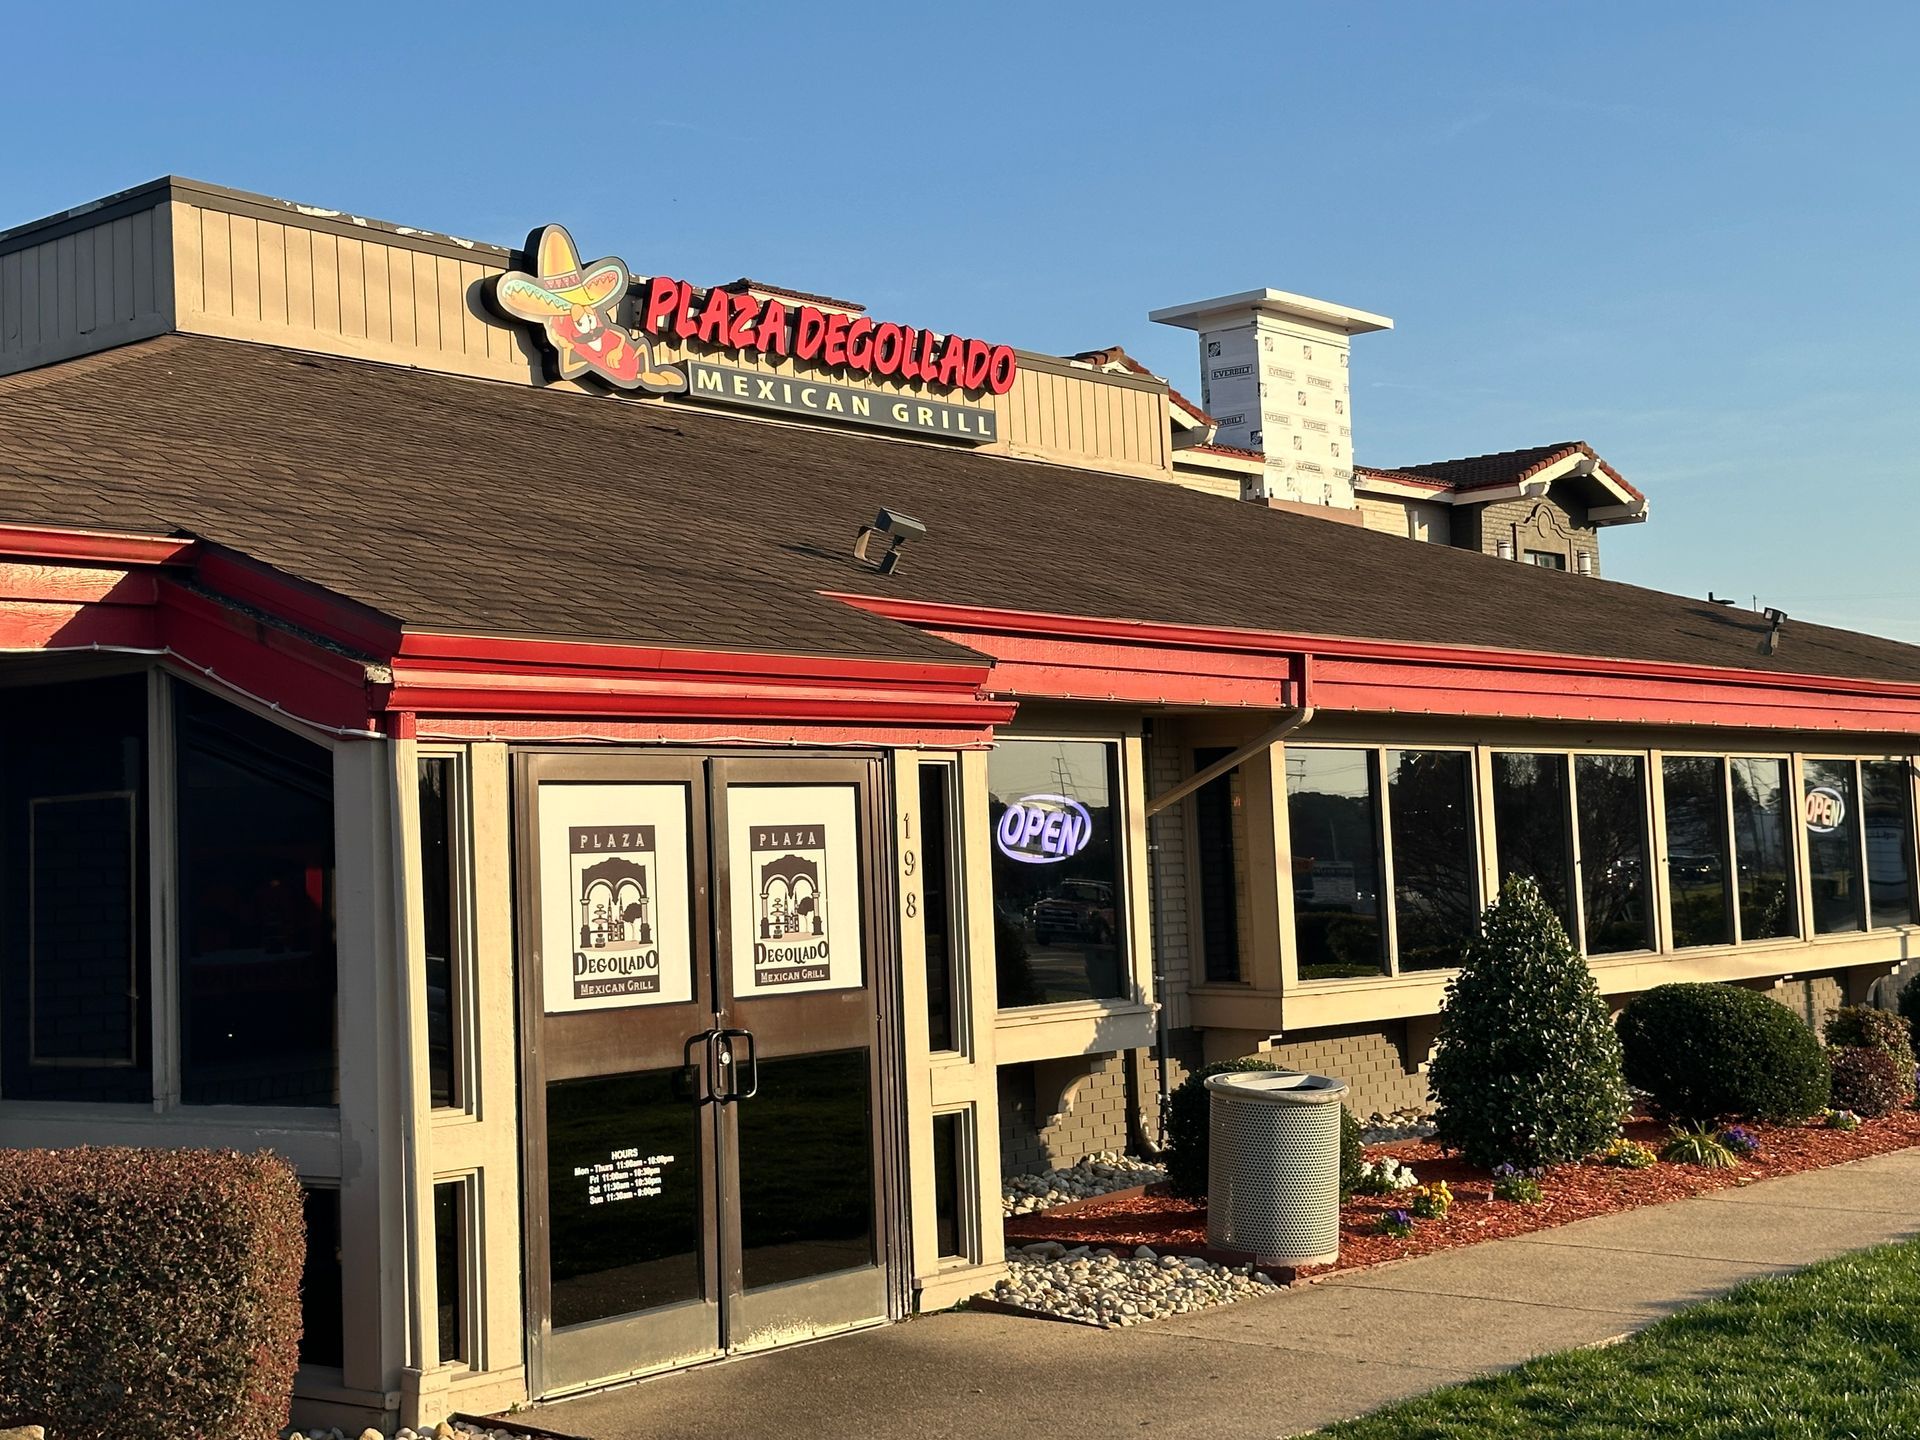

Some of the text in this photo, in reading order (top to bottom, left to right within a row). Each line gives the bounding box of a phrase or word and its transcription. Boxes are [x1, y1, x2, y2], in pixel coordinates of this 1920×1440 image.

[645, 276, 1017, 395] PLAZA DEGOLLADO
[1213, 366, 1251, 379] EVERBILT
[698, 369, 992, 436] MEXICAN GRILL
[1805, 793, 1841, 828] OPEN
[1001, 804, 1083, 856] OPEN
[580, 832, 645, 849] PLAZA
[759, 831, 817, 847] PLAZA
[903, 812, 917, 919] 198
[760, 968, 825, 983] MEXICAN GRILL
[580, 980, 654, 996] MEXICAN GRILL
[611, 1148, 638, 1160] HOURS
[574, 1167, 589, 1176] Mon
[594, 1164, 614, 1173] Thurs
[589, 1175, 599, 1184] Fri
[588, 1185, 601, 1195] Sat
[589, 1195, 604, 1205] Sun
